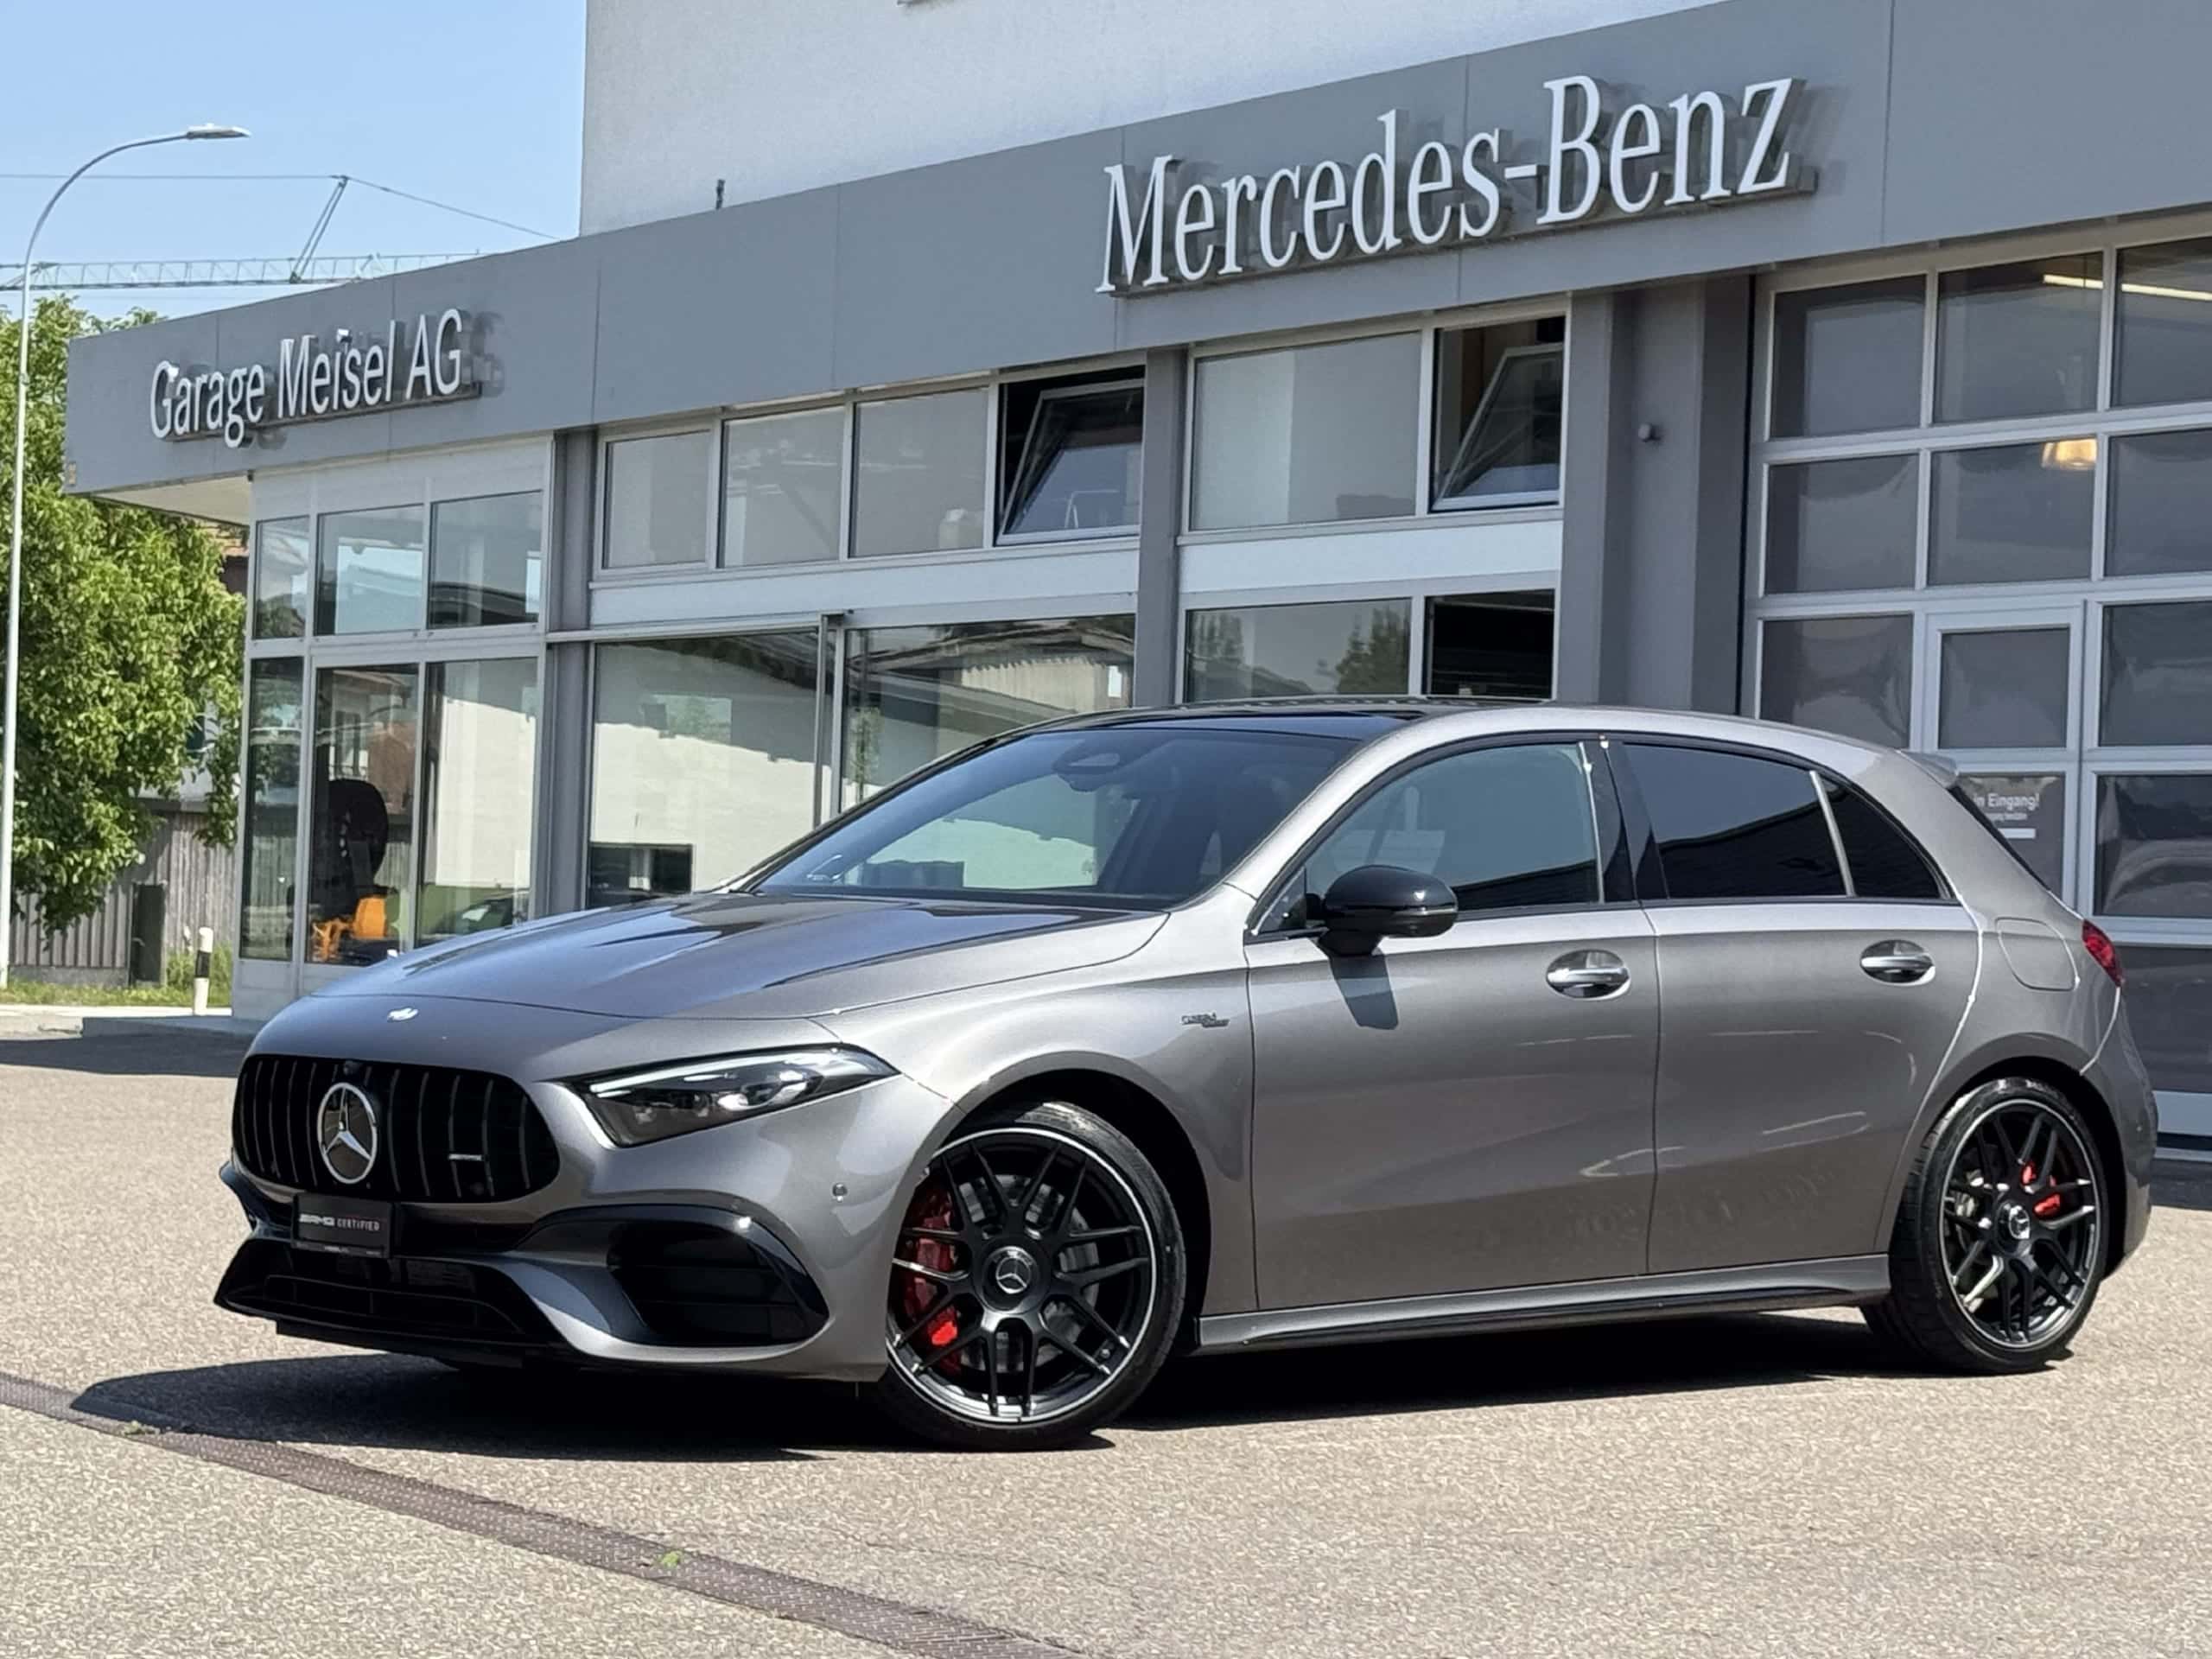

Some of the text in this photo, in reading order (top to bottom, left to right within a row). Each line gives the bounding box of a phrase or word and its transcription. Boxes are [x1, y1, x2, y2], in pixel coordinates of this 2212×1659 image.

[1095, 74, 1796, 295] Mercedes-Benz
[149, 308, 464, 448] Garage Meisel AG
[337, 1217, 380, 1231] CERTIFIED
